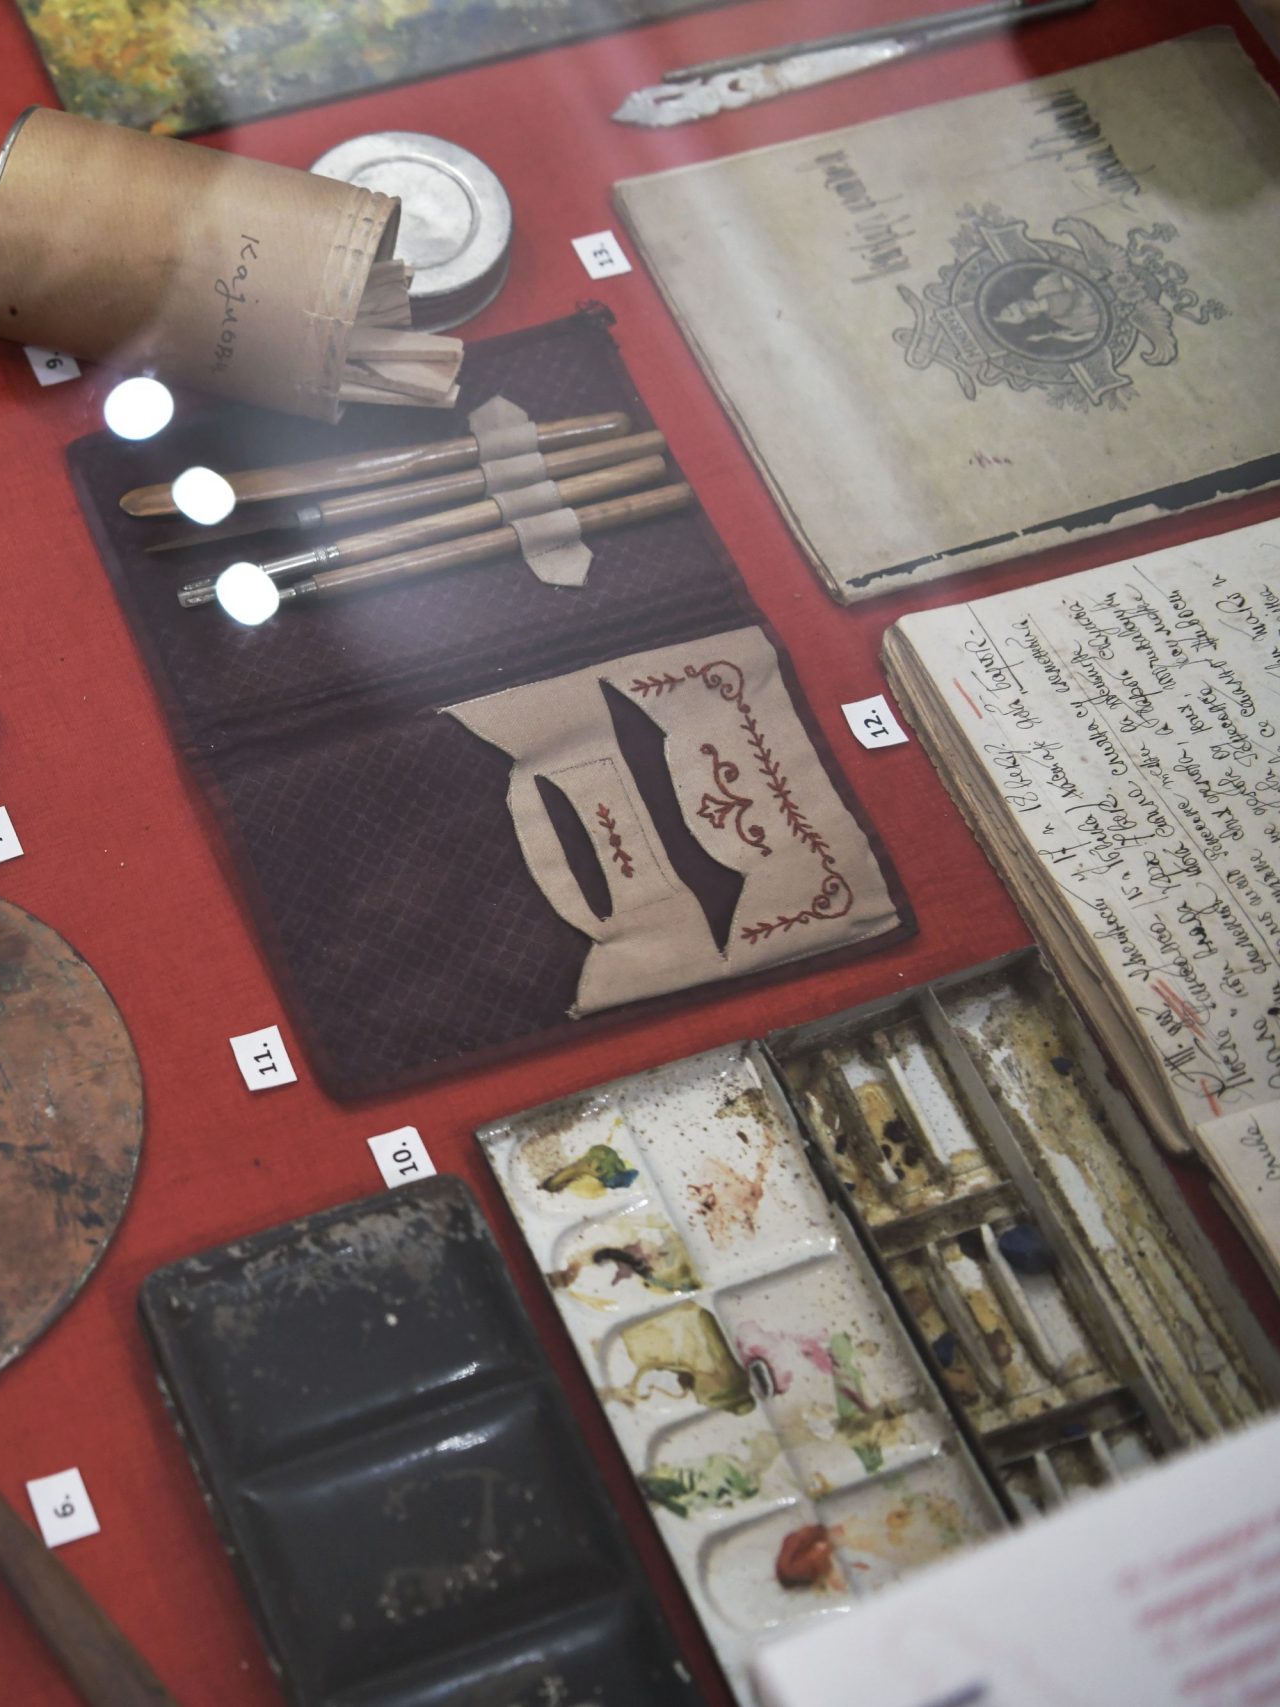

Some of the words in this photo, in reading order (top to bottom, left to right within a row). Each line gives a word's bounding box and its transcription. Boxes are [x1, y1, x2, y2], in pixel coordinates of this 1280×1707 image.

[864, 708, 890, 739] 12.
[1006, 790, 1042, 813] 18
[252, 1042, 278, 1074] 11.
[391, 1142, 419, 1175] 10.
[52, 1493, 75, 1518] 6.
